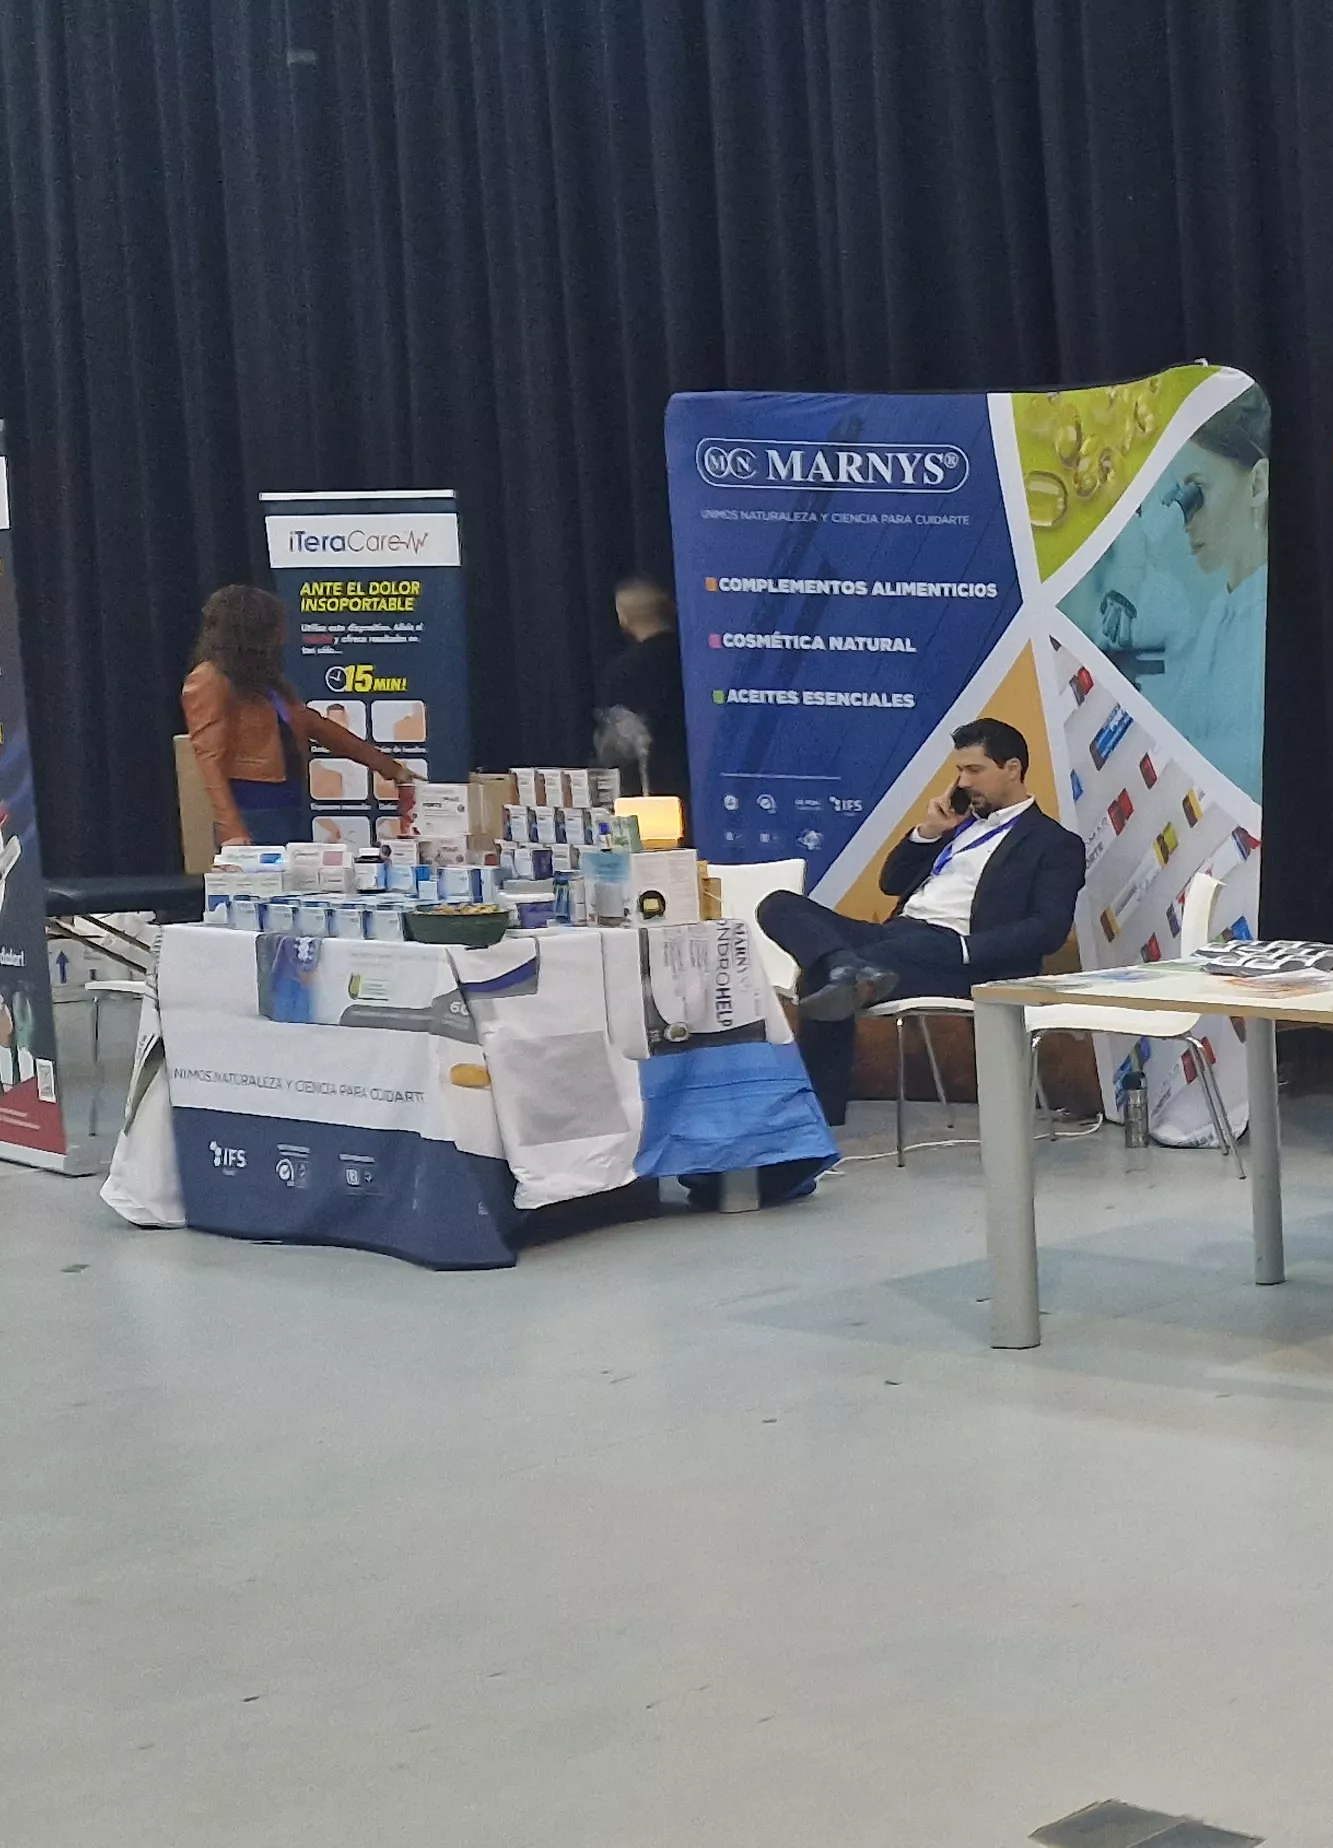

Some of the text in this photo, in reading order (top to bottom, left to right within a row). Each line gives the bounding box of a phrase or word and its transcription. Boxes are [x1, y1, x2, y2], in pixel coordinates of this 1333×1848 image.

[740, 510, 817, 523] NATURALEZA
[831, 512, 879, 524] CIENCIA
[881, 513, 912, 525] PARA
[915, 514, 970, 526] CUIDARTE
[288, 529, 405, 552] iTeraCare
[300, 580, 422, 596] ANTE EL DOLOR
[719, 577, 998, 598] COMPLEMENTOS ALIMENTICIOS
[300, 597, 414, 612] INSOPORTABLE
[723, 631, 917, 653] COSMÉTICA NATURAL
[343, 664, 375, 693] 15
[727, 688, 915, 708] ACEITES ESENCIALES
[222, 1148, 247, 1168] IFS
